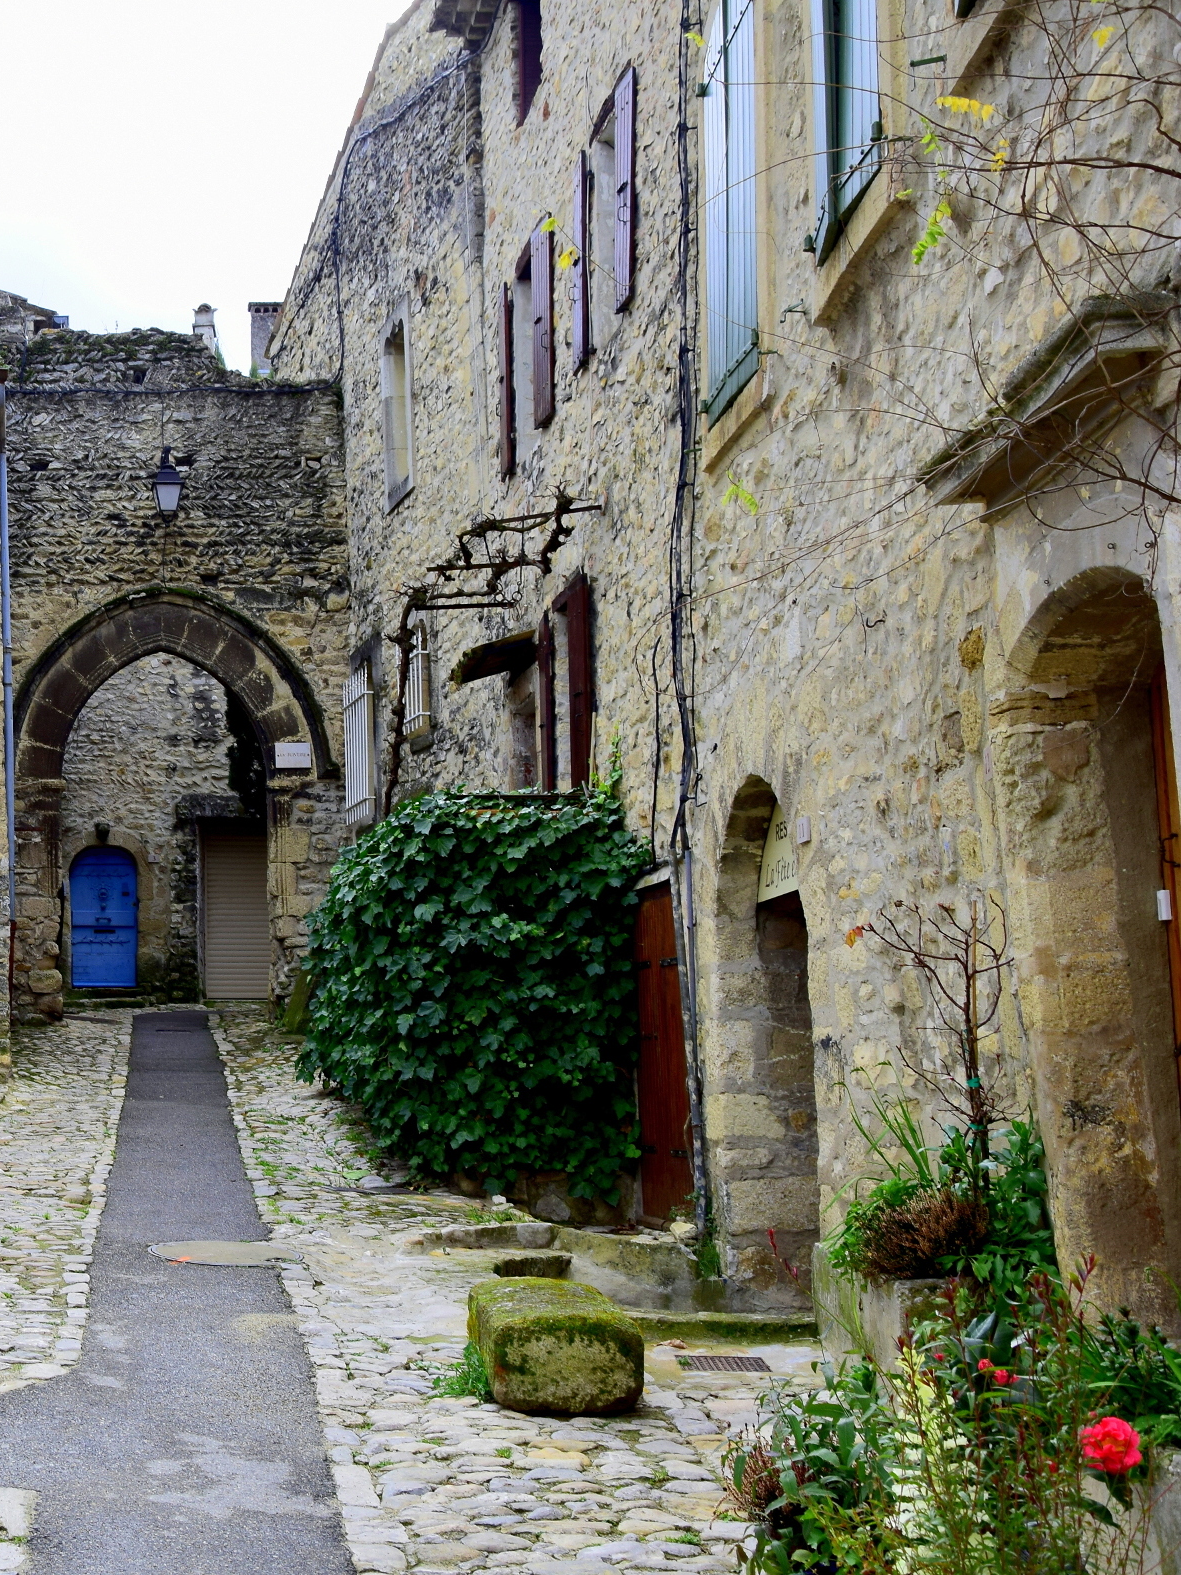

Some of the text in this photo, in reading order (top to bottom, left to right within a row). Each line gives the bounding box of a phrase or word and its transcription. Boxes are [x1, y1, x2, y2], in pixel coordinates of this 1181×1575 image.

[775, 820, 788, 841] RES
[798, 823, 805, 839] 11
[765, 863, 775, 888] La
[775, 856, 790, 889] Fête
